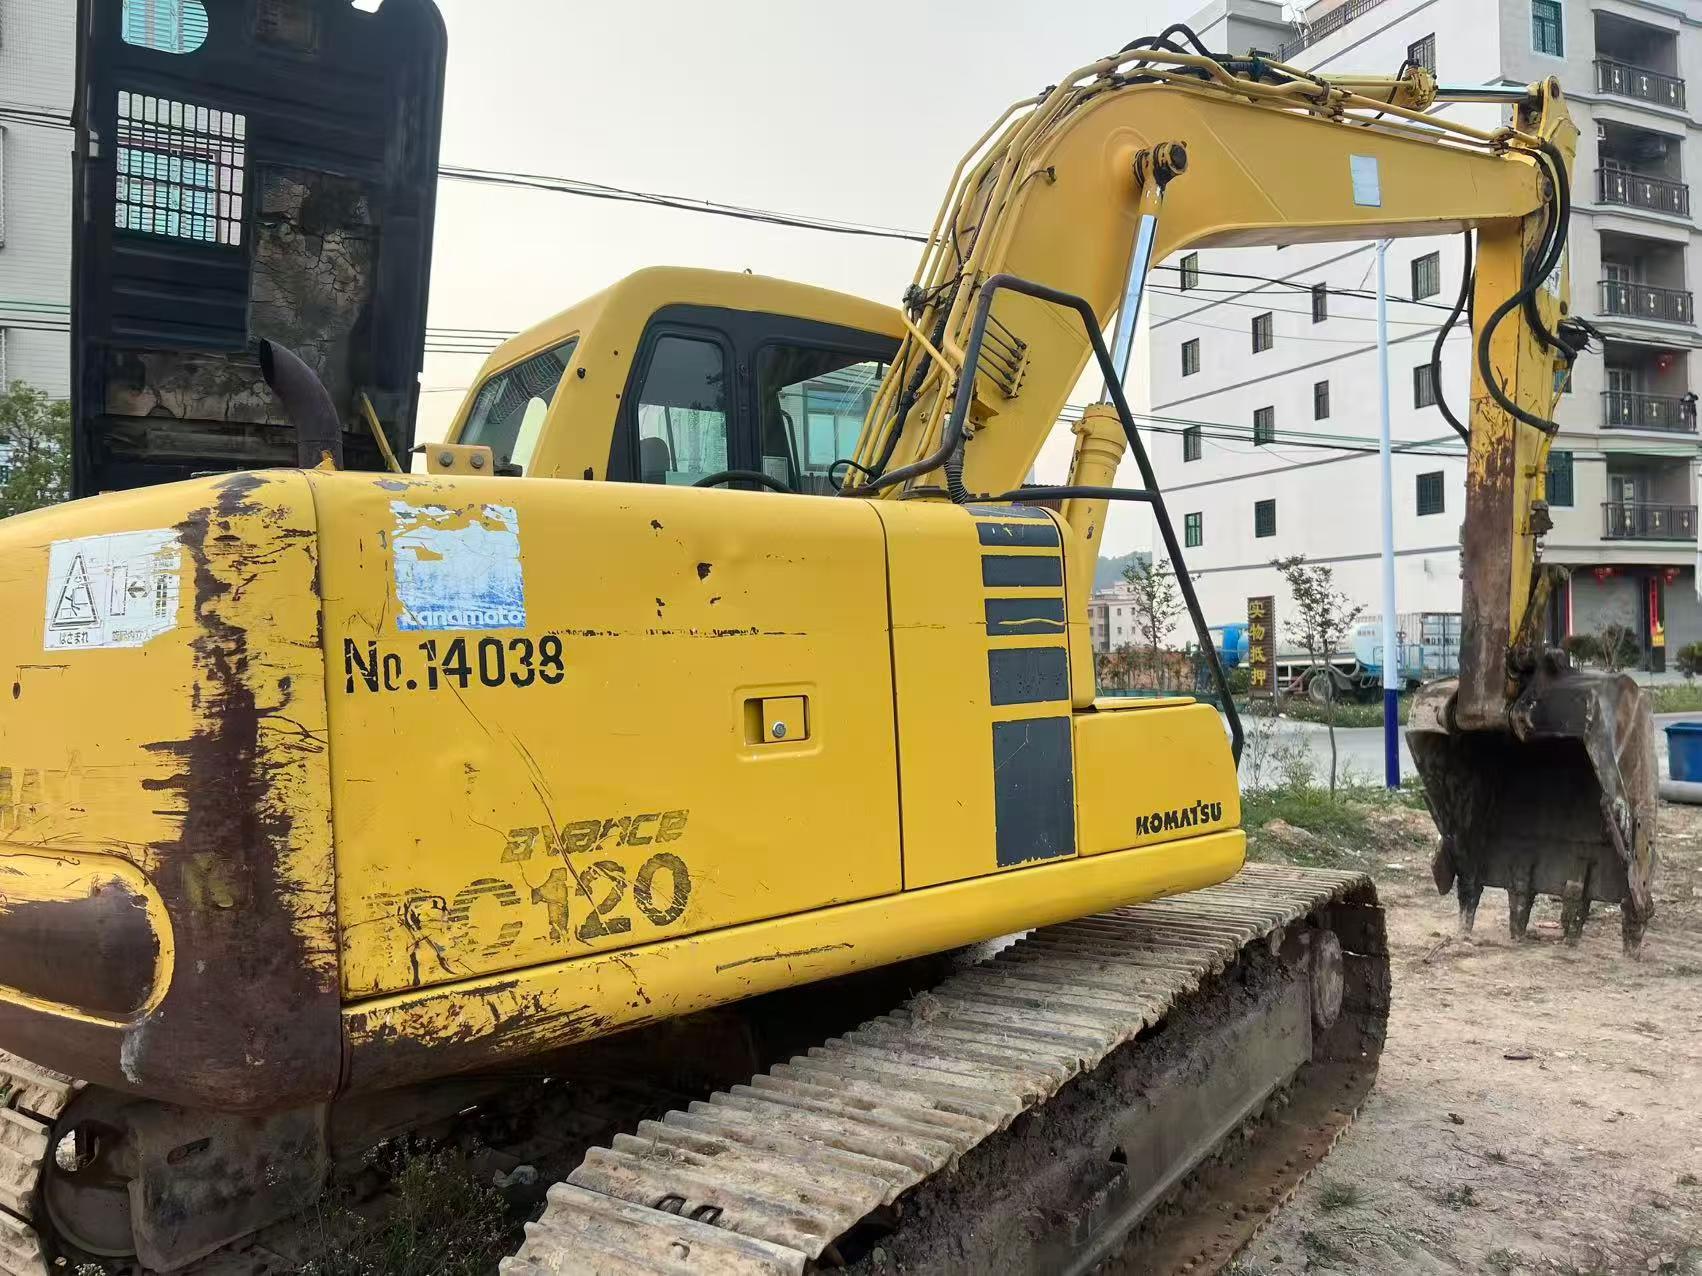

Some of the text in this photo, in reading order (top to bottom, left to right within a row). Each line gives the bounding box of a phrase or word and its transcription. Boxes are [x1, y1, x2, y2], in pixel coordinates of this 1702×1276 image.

[405, 608, 523, 626] anamoto
[60, 631, 89, 645] はさまれ
[1248, 601, 1267, 686] 实物抵押
[1135, 800, 1222, 837] KOMATSU
[361, 852, 692, 958] C120
